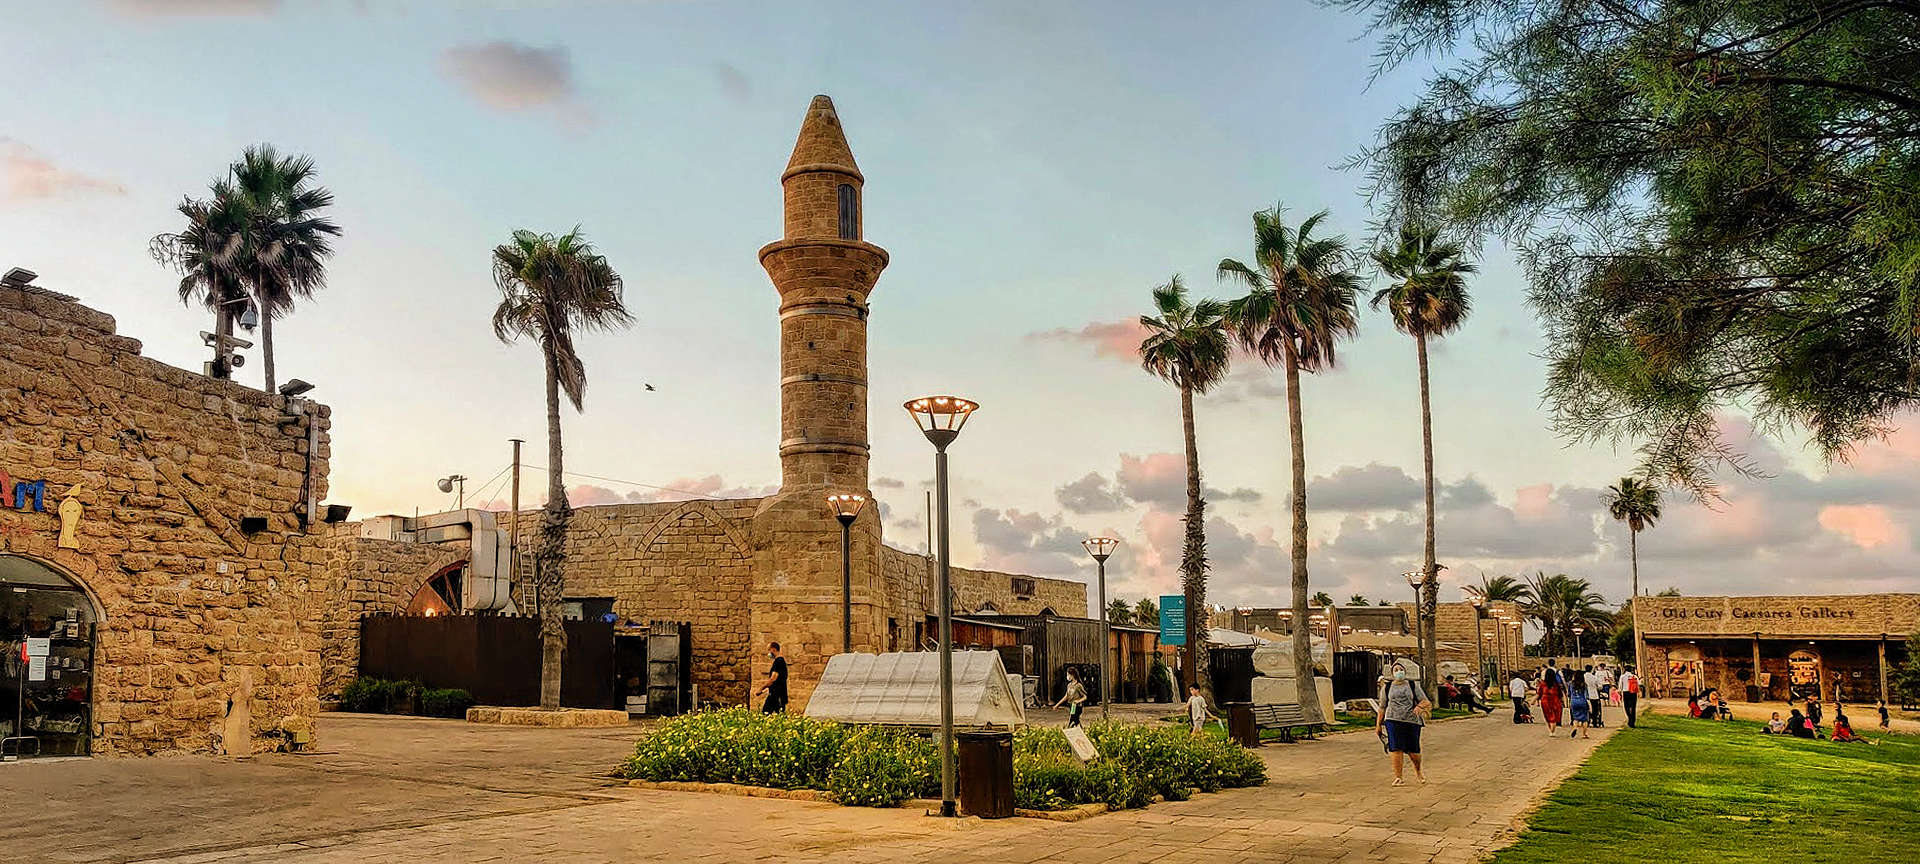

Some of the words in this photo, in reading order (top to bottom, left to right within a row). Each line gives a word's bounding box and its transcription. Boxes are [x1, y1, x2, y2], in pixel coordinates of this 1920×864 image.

[1662, 607, 1686, 618] Old
[1732, 607, 1793, 618] Caesarea
[1799, 607, 1855, 619] Gallery
